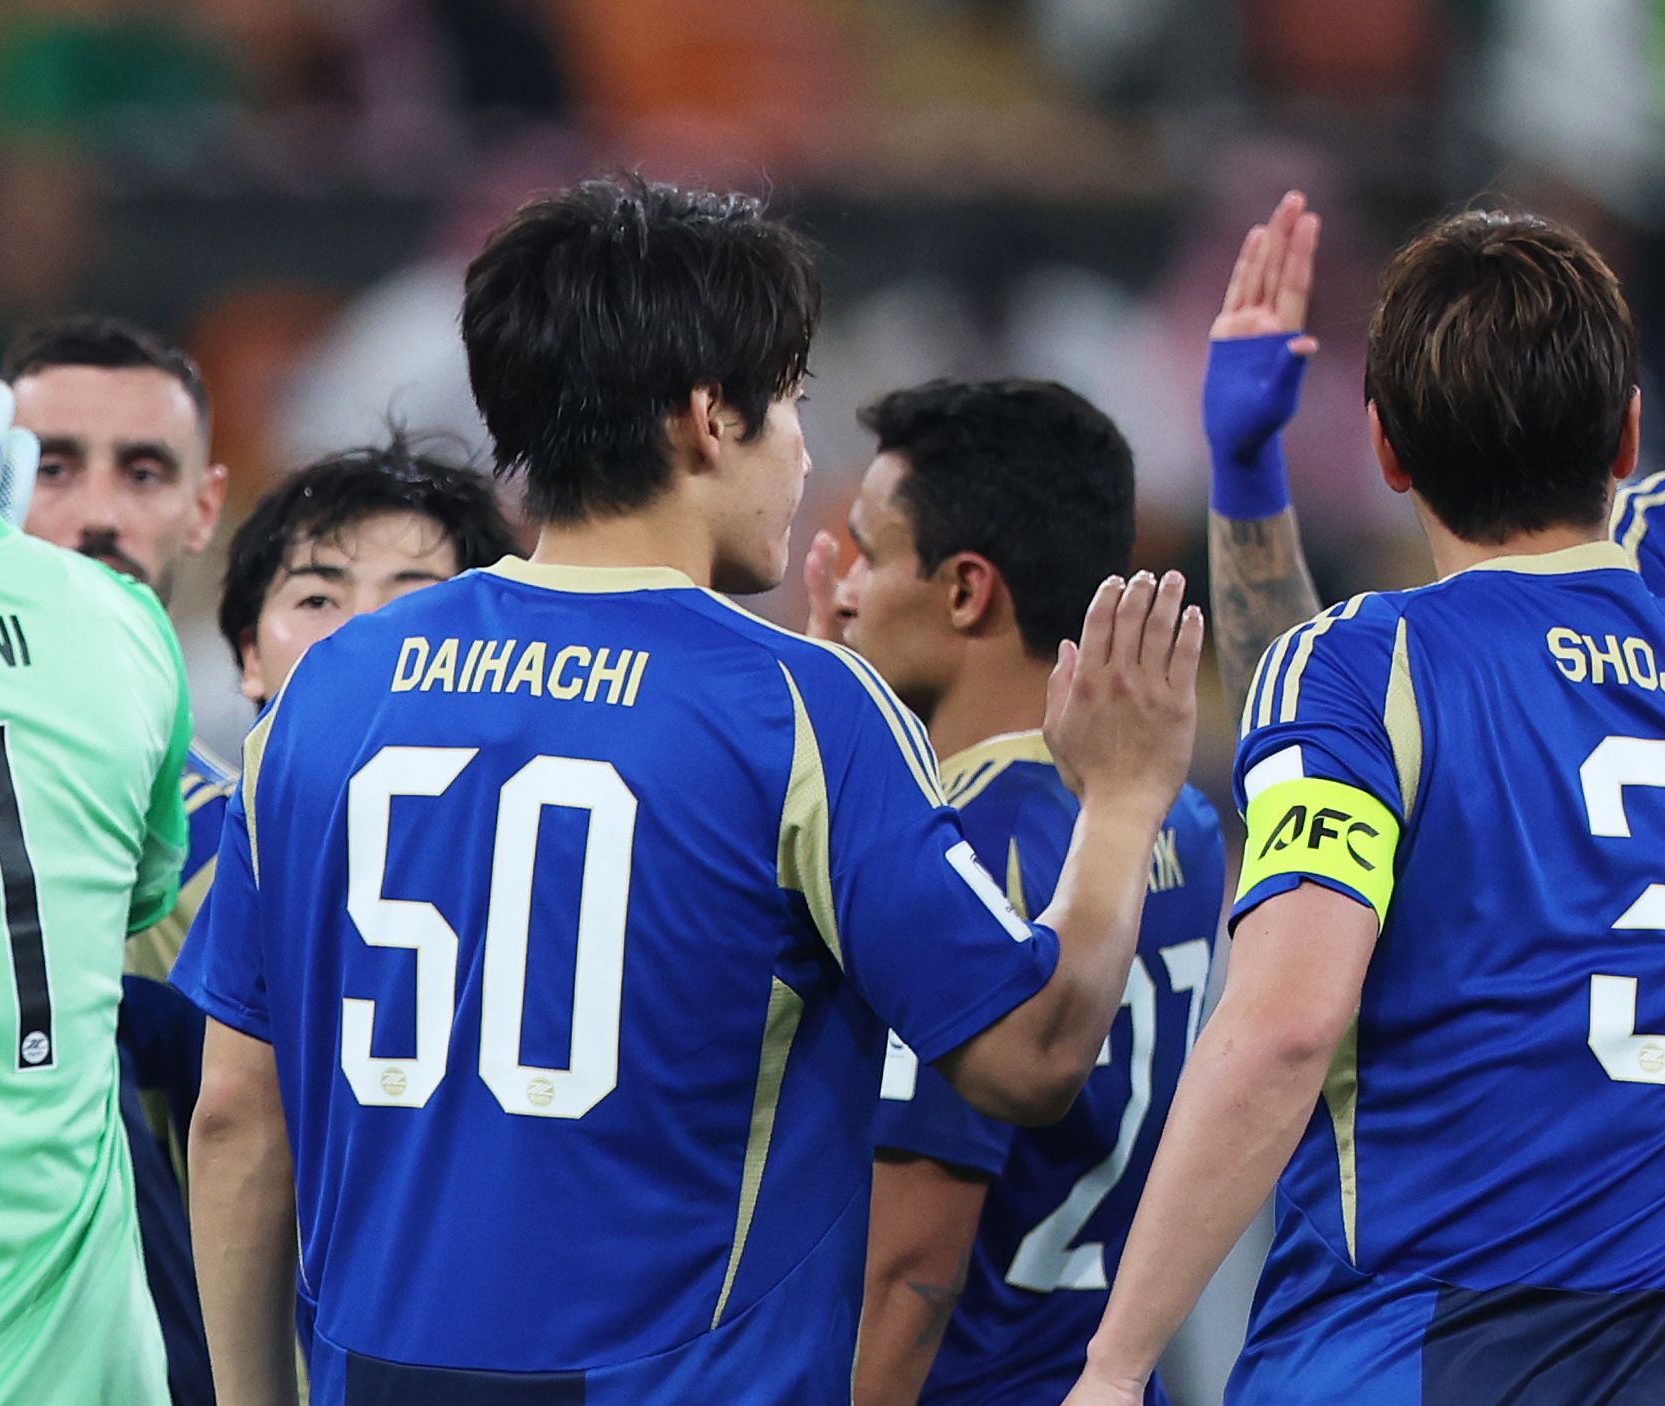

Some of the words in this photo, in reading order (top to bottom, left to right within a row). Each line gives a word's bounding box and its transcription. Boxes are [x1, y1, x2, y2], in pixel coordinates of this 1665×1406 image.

[390, 636, 650, 707] DAIHACHI
[1258, 805, 1380, 871] AFC
[340, 745, 637, 1119] 50
